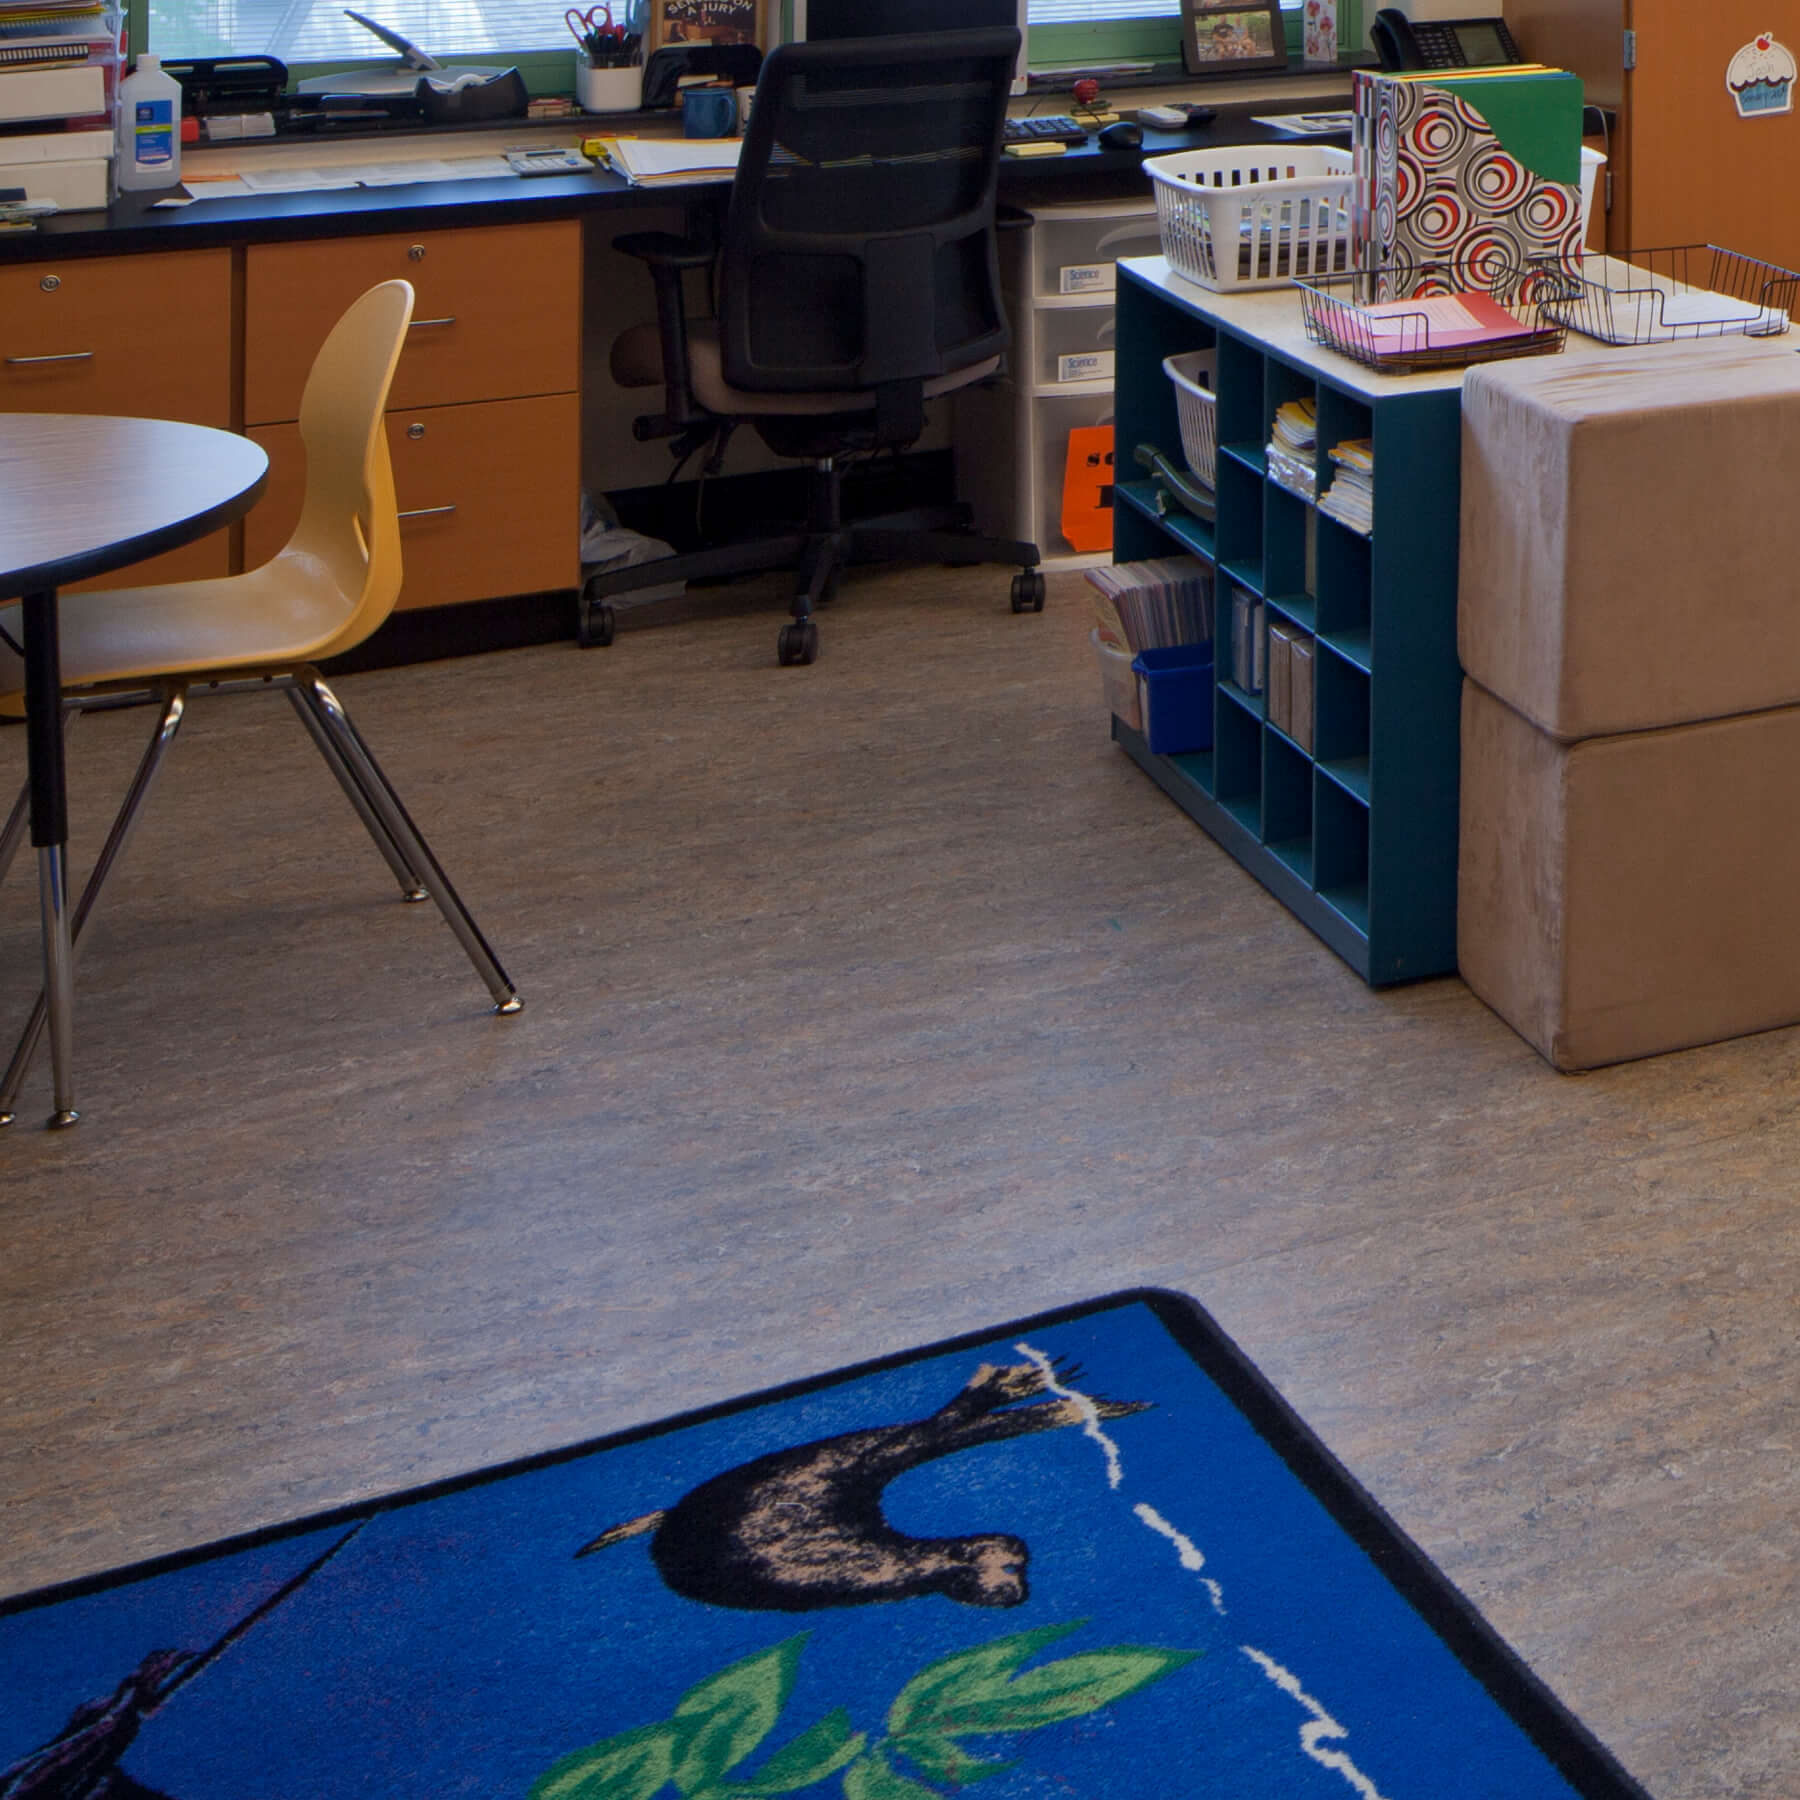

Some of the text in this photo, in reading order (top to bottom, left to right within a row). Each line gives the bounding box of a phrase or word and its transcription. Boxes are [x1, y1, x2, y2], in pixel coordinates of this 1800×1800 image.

[688, 3, 737, 16] A JURY
[1069, 269, 1099, 281] Science
[1067, 357, 1098, 369] Science
